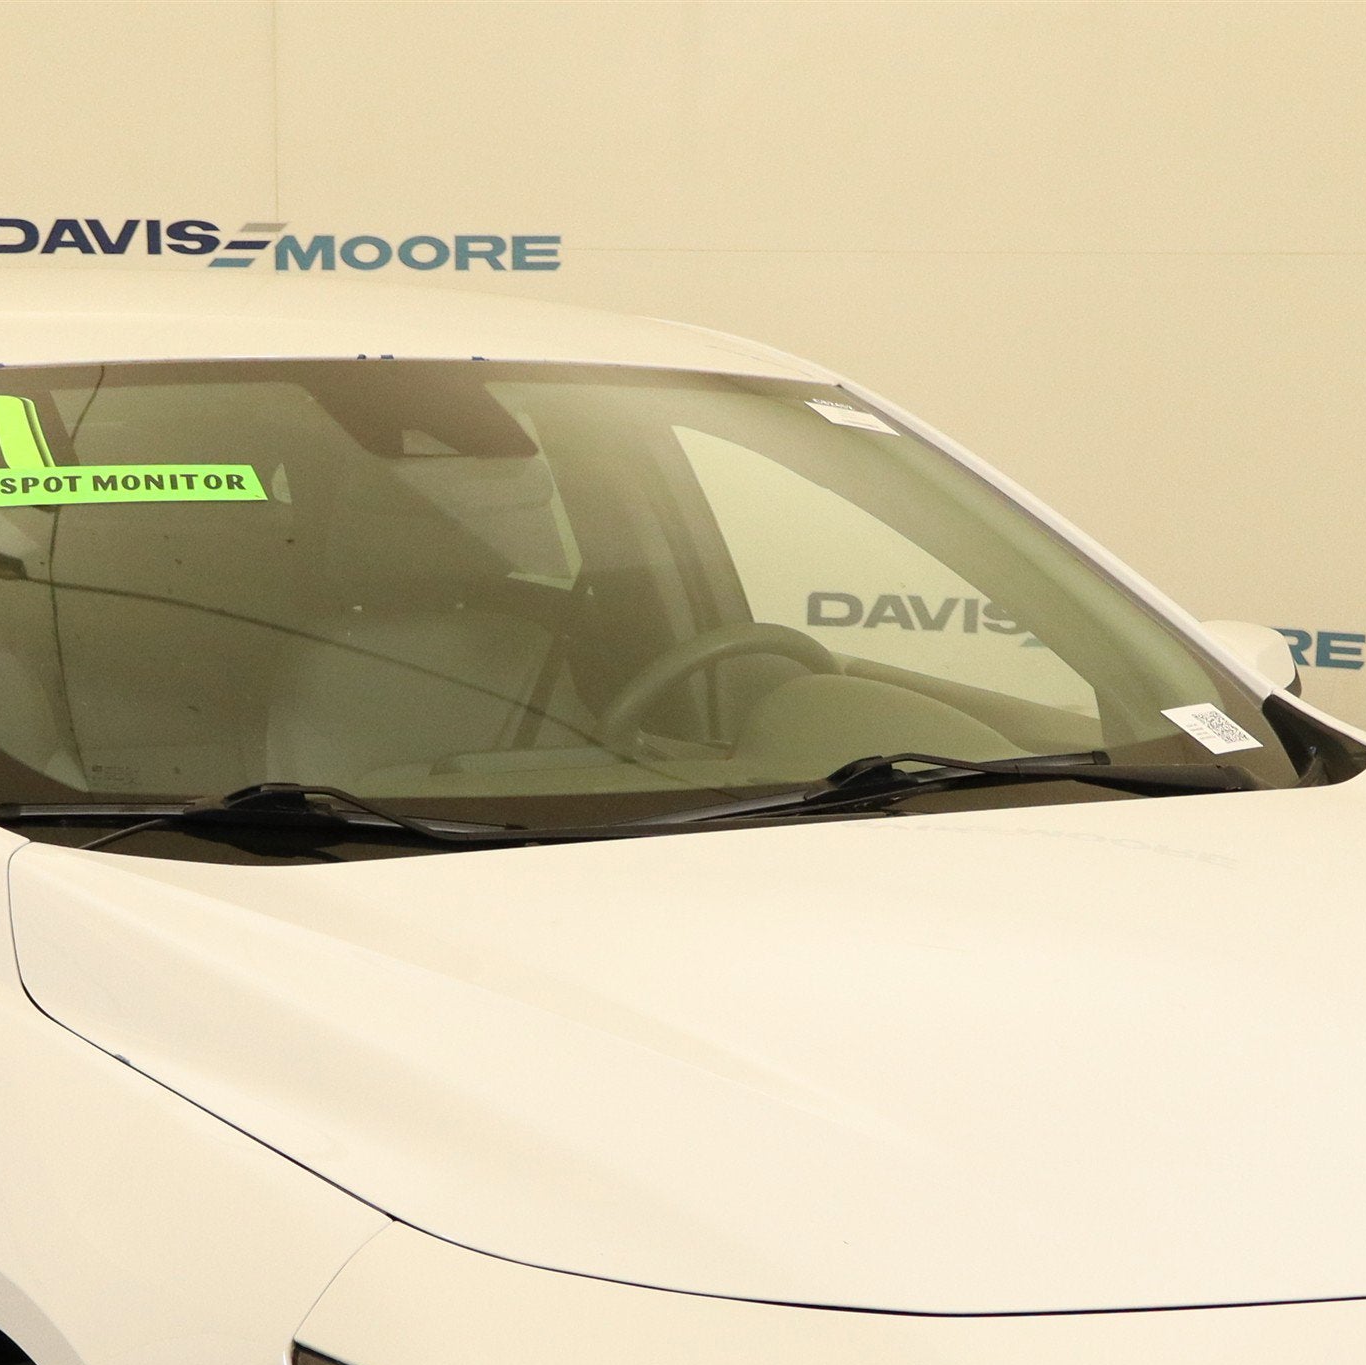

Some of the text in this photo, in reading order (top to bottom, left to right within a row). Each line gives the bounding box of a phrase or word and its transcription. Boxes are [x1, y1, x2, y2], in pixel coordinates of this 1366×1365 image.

[274, 234, 563, 272] MOORE
[0, 474, 82, 495] SPOT
[91, 472, 247, 493] MONITOR
